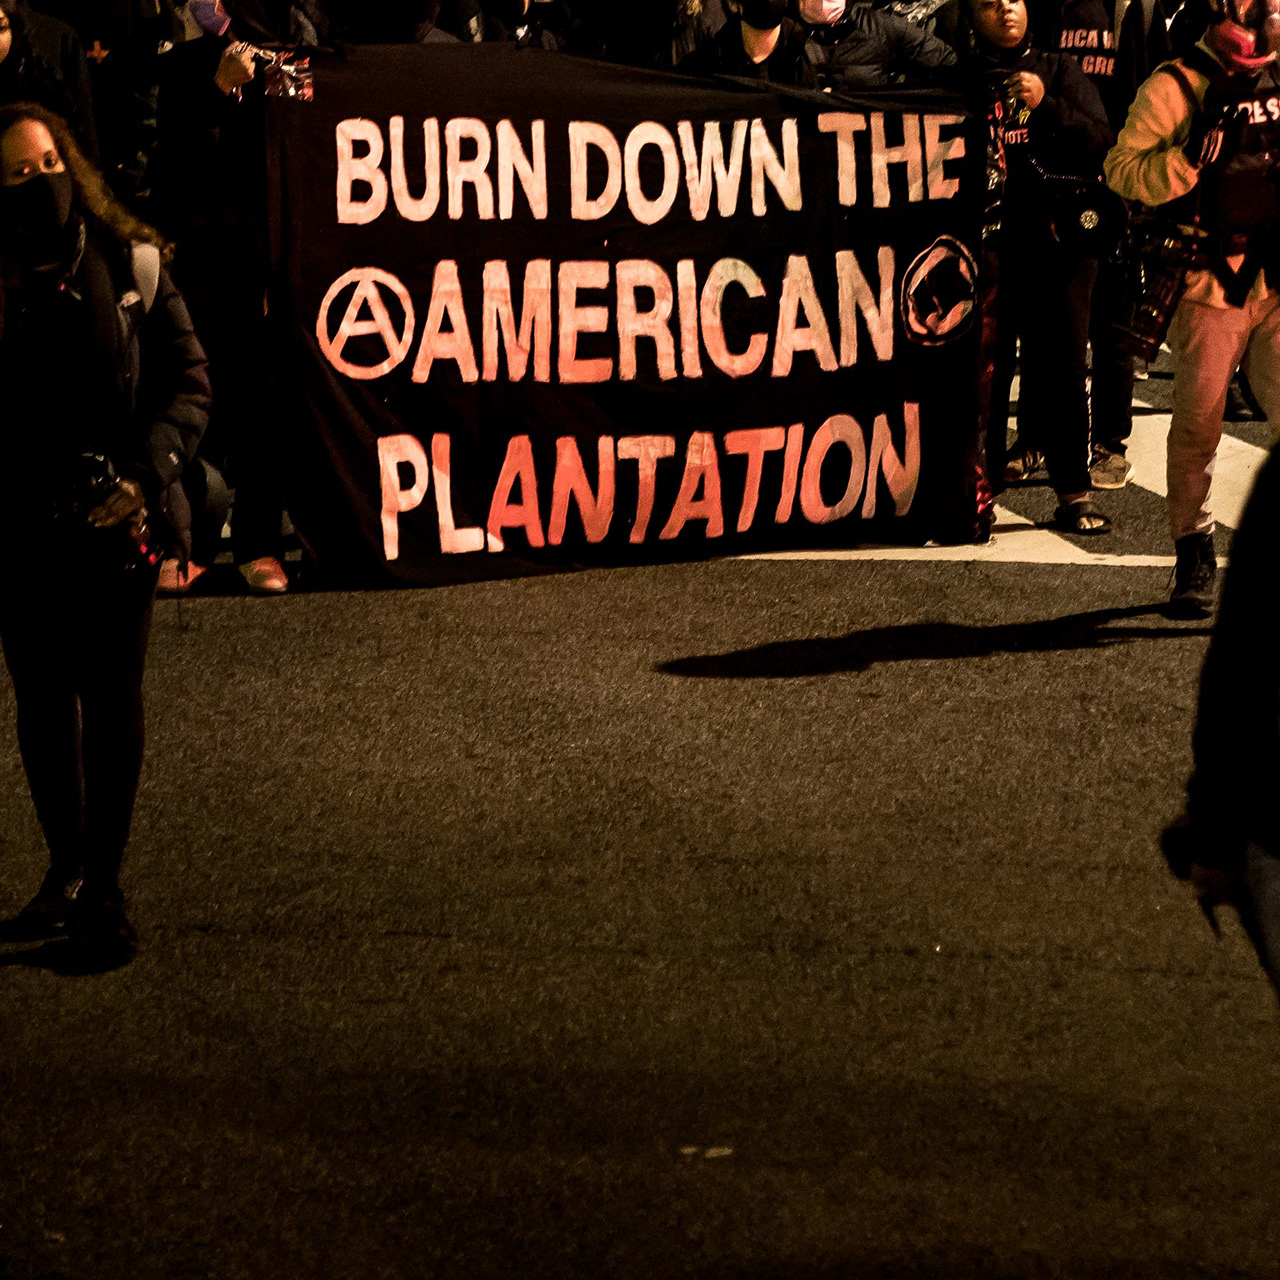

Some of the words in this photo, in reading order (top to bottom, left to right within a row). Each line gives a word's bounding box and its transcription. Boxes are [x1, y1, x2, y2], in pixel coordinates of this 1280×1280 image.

[335, 115, 549, 225] BURN
[568, 116, 803, 225] DOWN
[817, 111, 967, 209] THE
[412, 246, 896, 384] AMERICAN
[377, 401, 921, 561] PLANTATION
